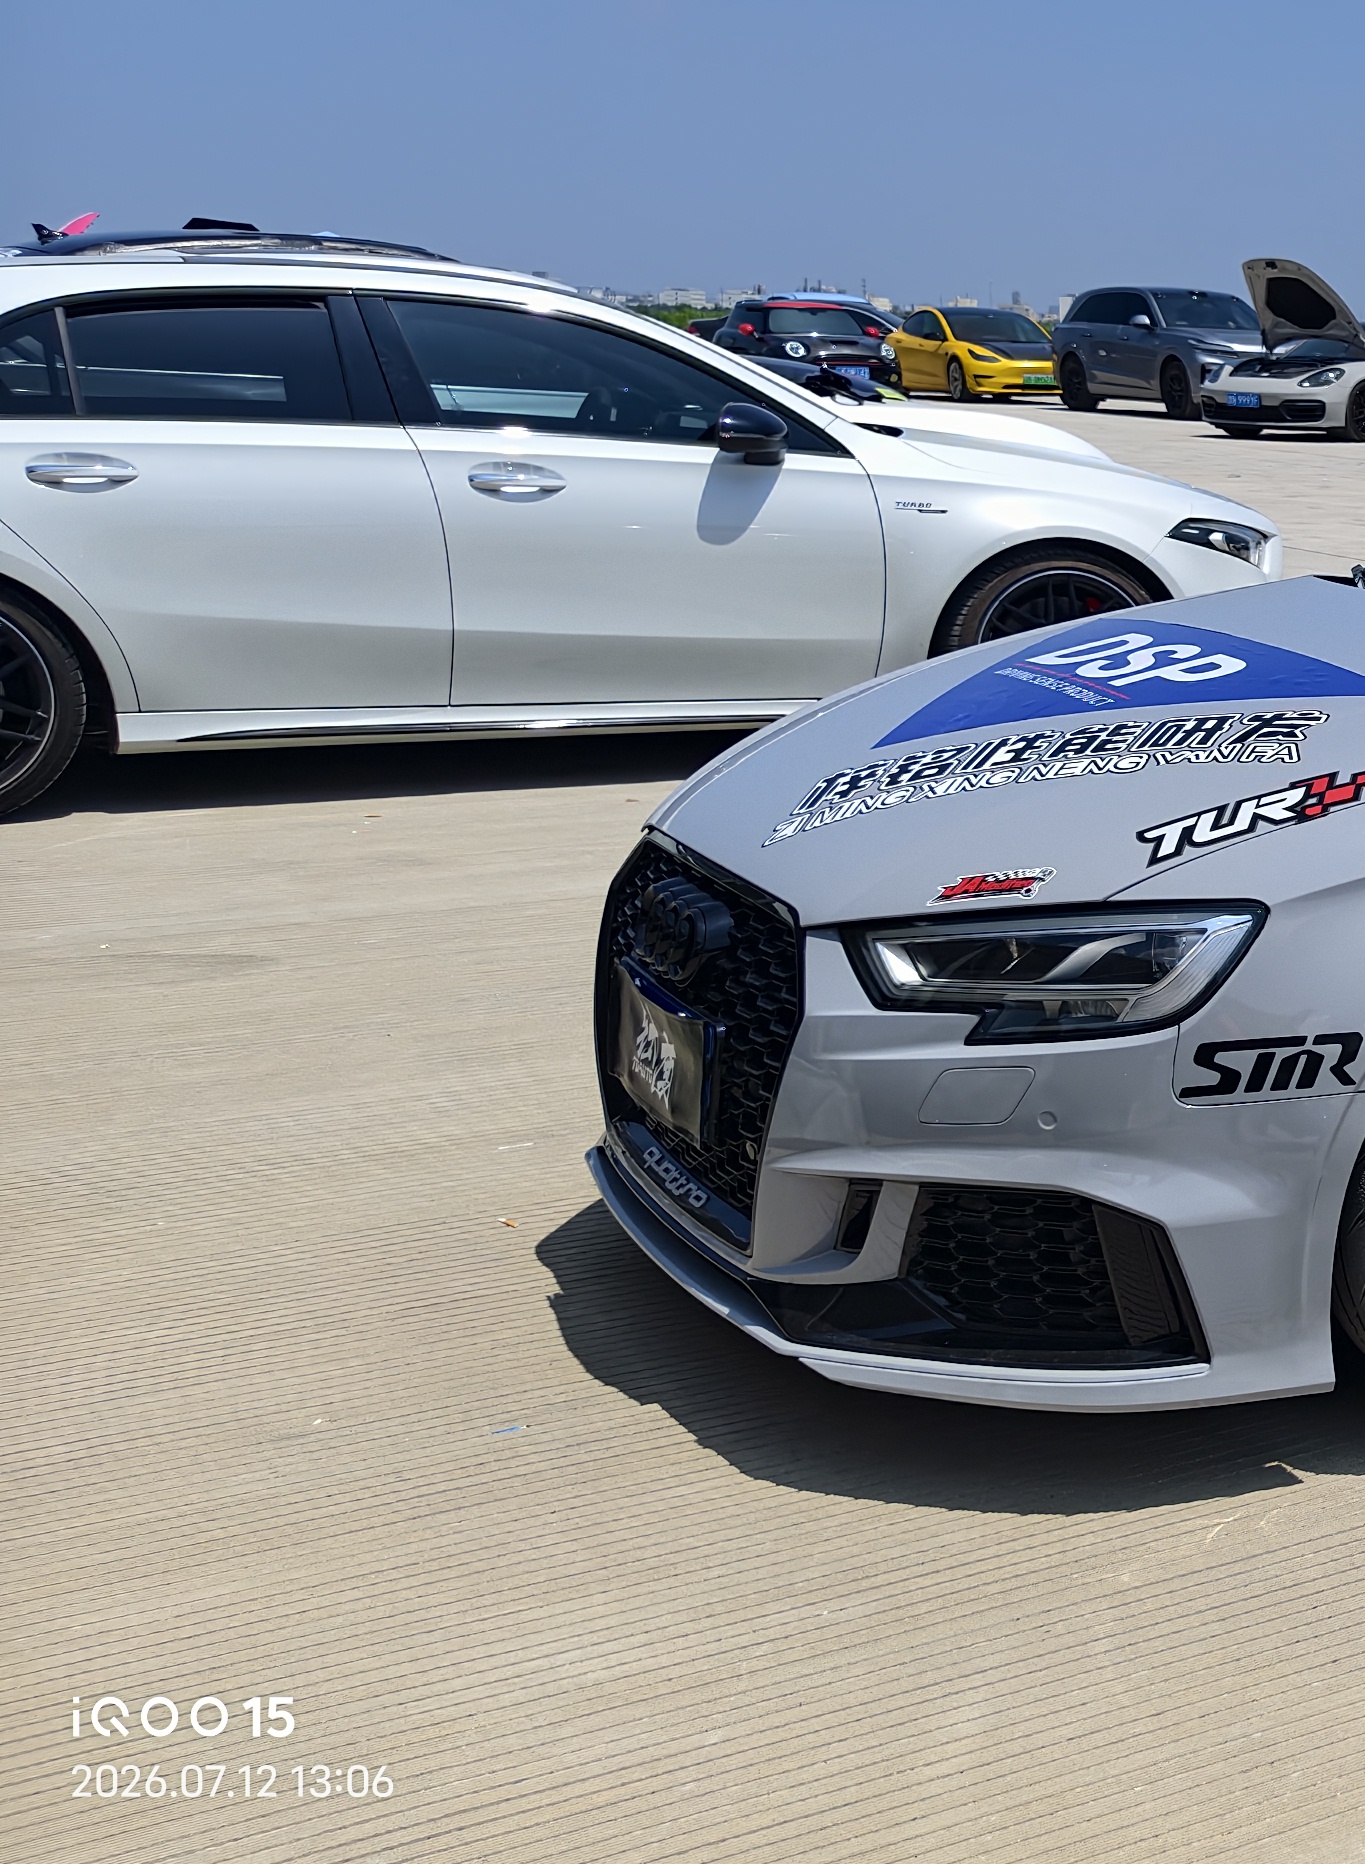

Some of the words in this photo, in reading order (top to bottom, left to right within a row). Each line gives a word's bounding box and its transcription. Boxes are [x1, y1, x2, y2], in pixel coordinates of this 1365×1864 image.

[1025, 633, 1247, 687] DSP
[803, 788, 914, 832] MING
[908, 767, 1019, 803] XING
[1017, 751, 1151, 785] NENG
[1239, 741, 1301, 764] FA
[941, 876, 985, 896] JA
[643, 1146, 708, 1208] quattro
